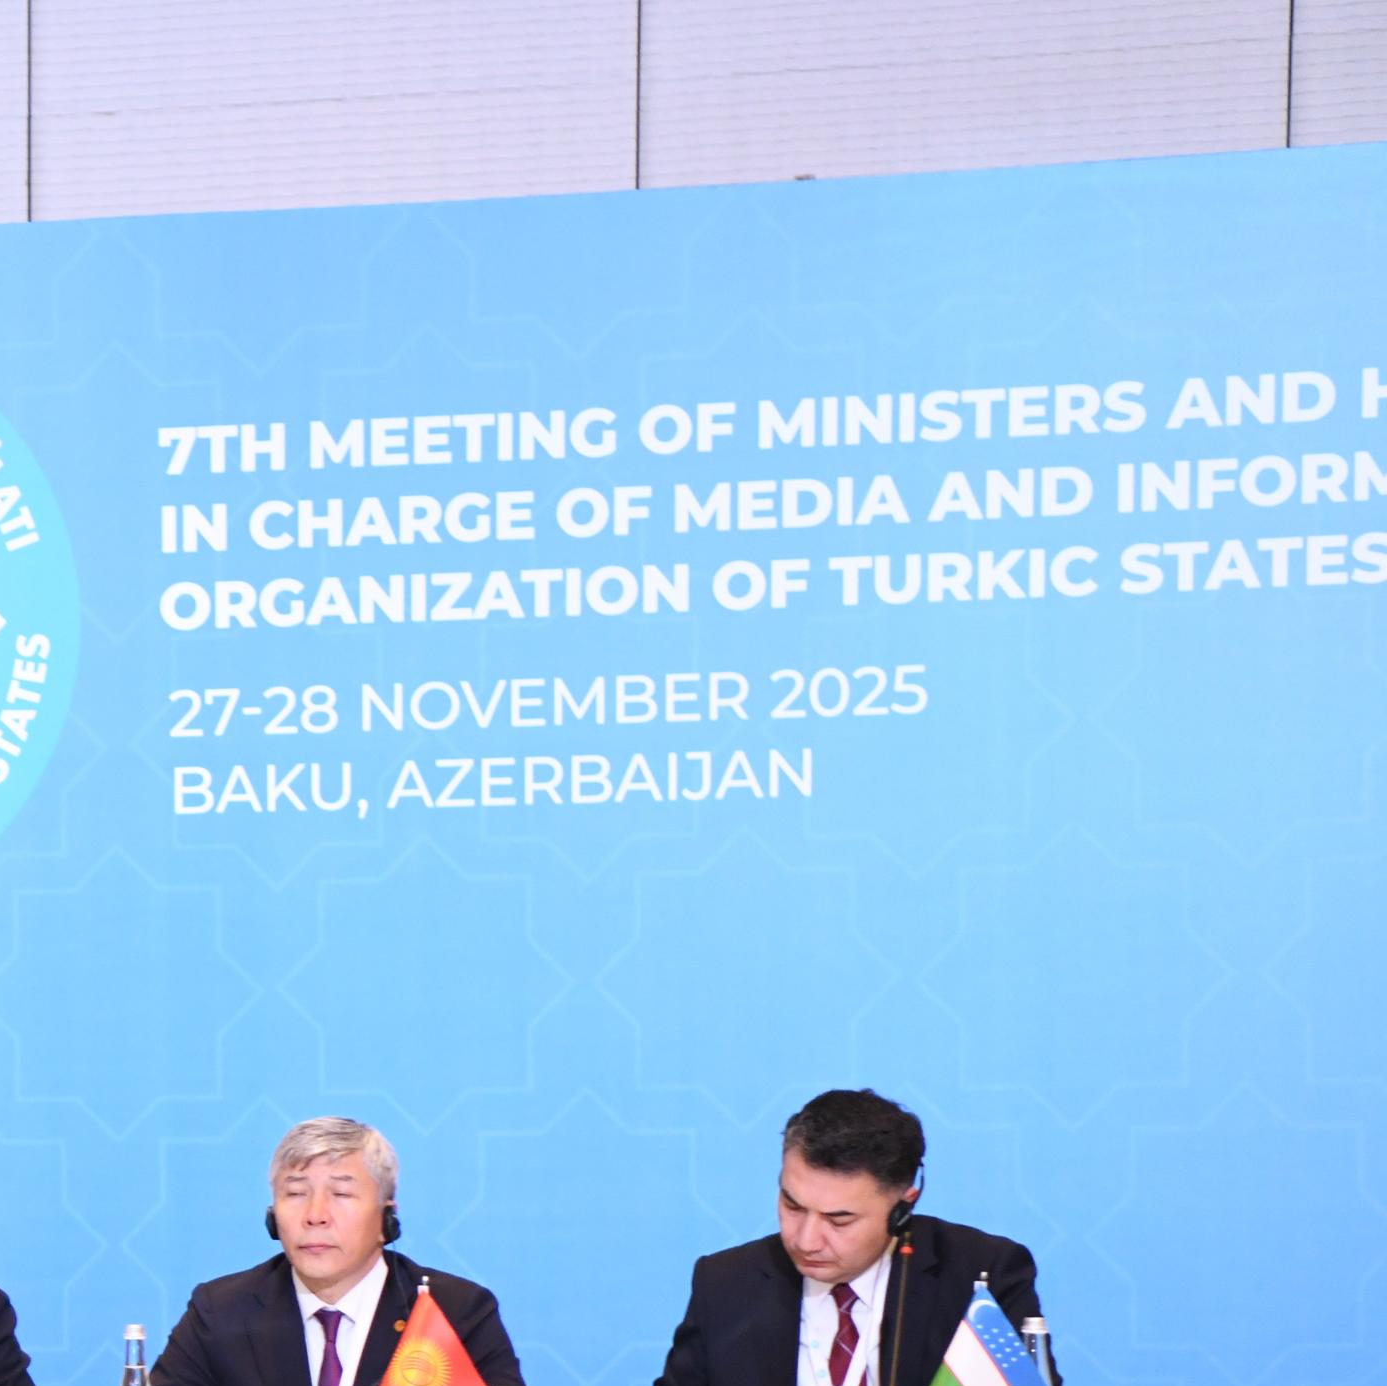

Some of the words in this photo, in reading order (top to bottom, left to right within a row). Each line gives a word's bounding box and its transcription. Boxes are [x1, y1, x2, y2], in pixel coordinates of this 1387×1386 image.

[159, 423, 285, 474] 7TH
[311, 408, 616, 468] MEETING
[640, 403, 735, 454] OF
[759, 381, 1146, 448] MINISTERS
[1167, 372, 1335, 428] AND
[162, 504, 227, 553] IN
[250, 491, 534, 549] CHARGE
[557, 486, 651, 537] OF
[675, 476, 909, 532] MEDIA
[929, 467, 1092, 521] AND
[160, 564, 689, 630] ORGANIZATION
[713, 559, 810, 610] OF
[829, 547, 1098, 605] TURKIC
[1122, 533, 1387, 593] STATES
[170, 685, 338, 736] 27-28
[363, 672, 748, 731] NOVEMBER
[771, 665, 927, 718] 2025
[175, 763, 368, 818] BAKU,
[388, 749, 812, 808] AZERBAIJAN
